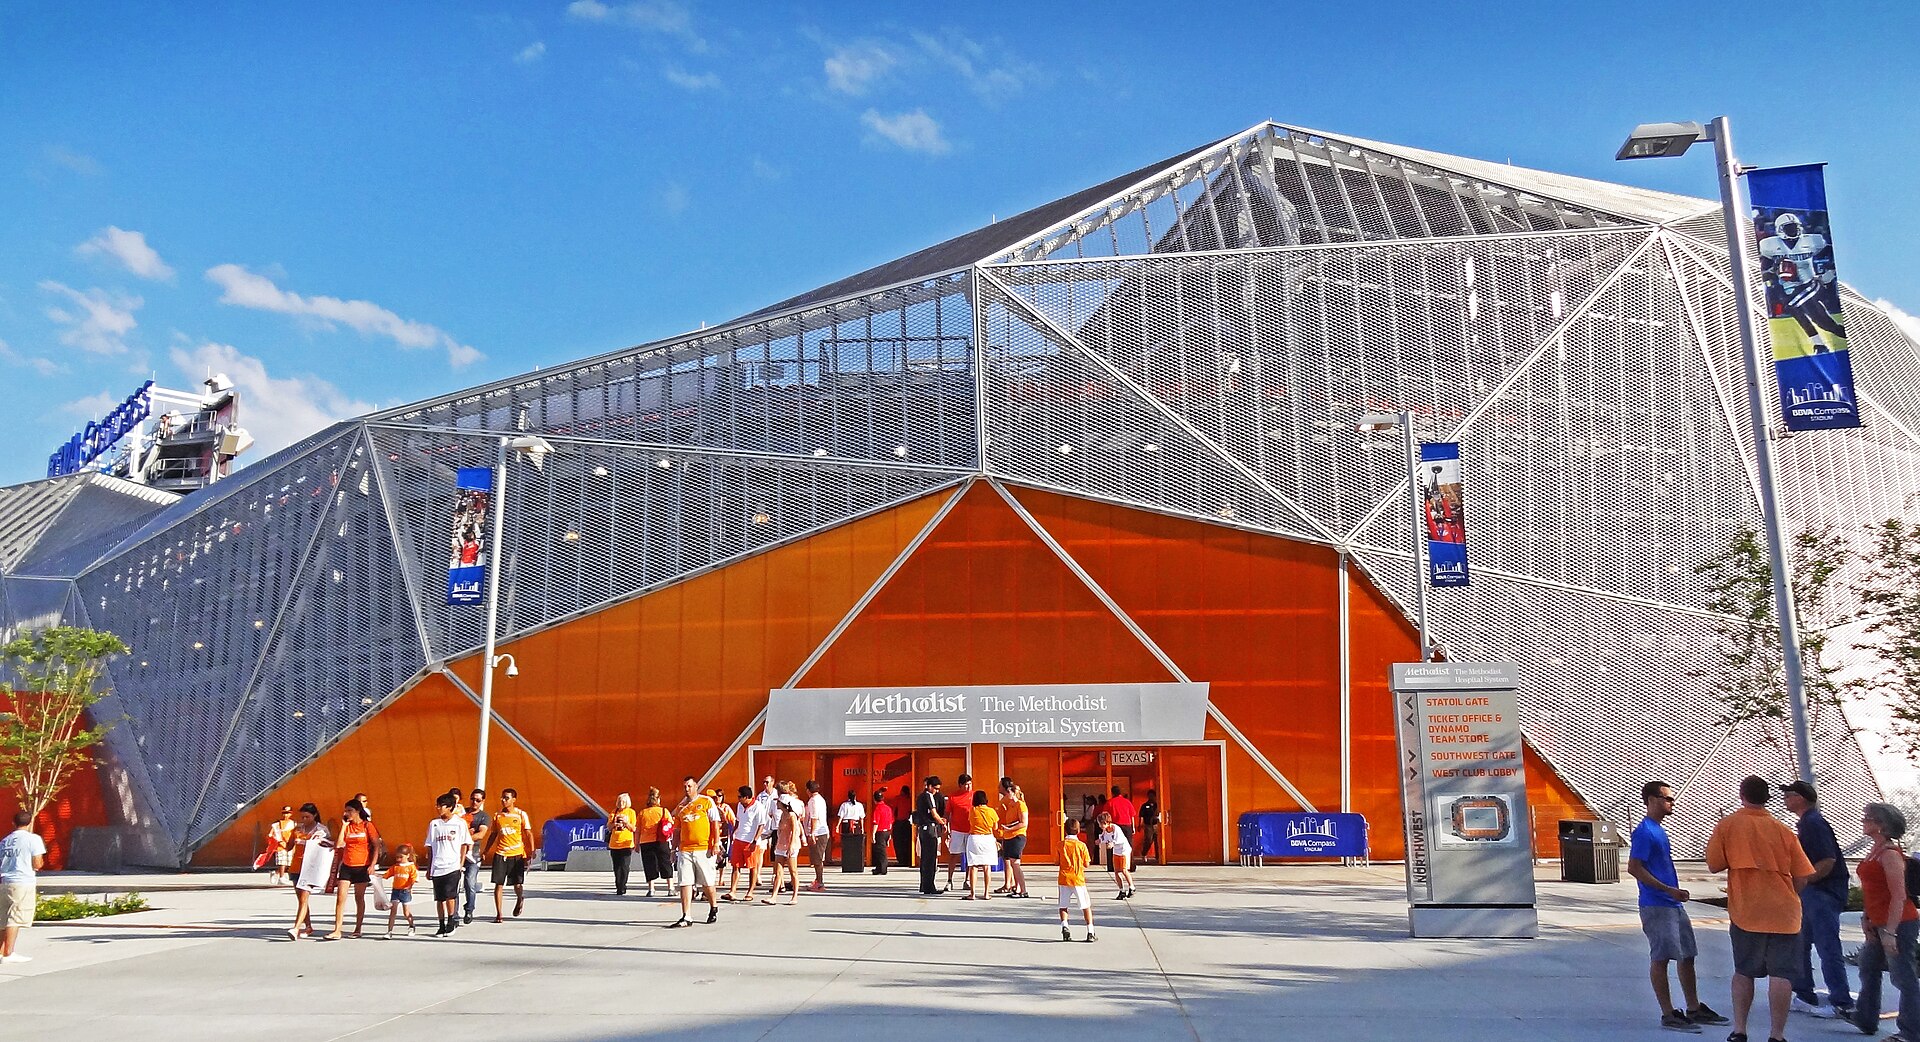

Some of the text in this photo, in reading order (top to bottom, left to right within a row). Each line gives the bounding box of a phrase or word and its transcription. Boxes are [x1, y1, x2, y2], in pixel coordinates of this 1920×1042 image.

[1792, 407, 1851, 417] BBVA Compass
[1404, 667, 1450, 676] Methodist
[1455, 676, 1510, 684] Hospital System
[845, 692, 1107, 715] Methodist The Methodist
[1426, 697, 1489, 706] STATOIL GATE
[1428, 714, 1502, 723] TICKET OFFICE &
[980, 717, 1126, 738] Hospital System
[1428, 724, 1470, 733] DYNAMO
[1429, 734, 1490, 744] TEAM STORE
[1112, 753, 1147, 763] TEXAS
[1431, 751, 1516, 760] SOUTHWEST GATE
[1432, 768, 1518, 778] WEST CLUB LOBBY
[1411, 810, 1427, 884] NORTHWEST
